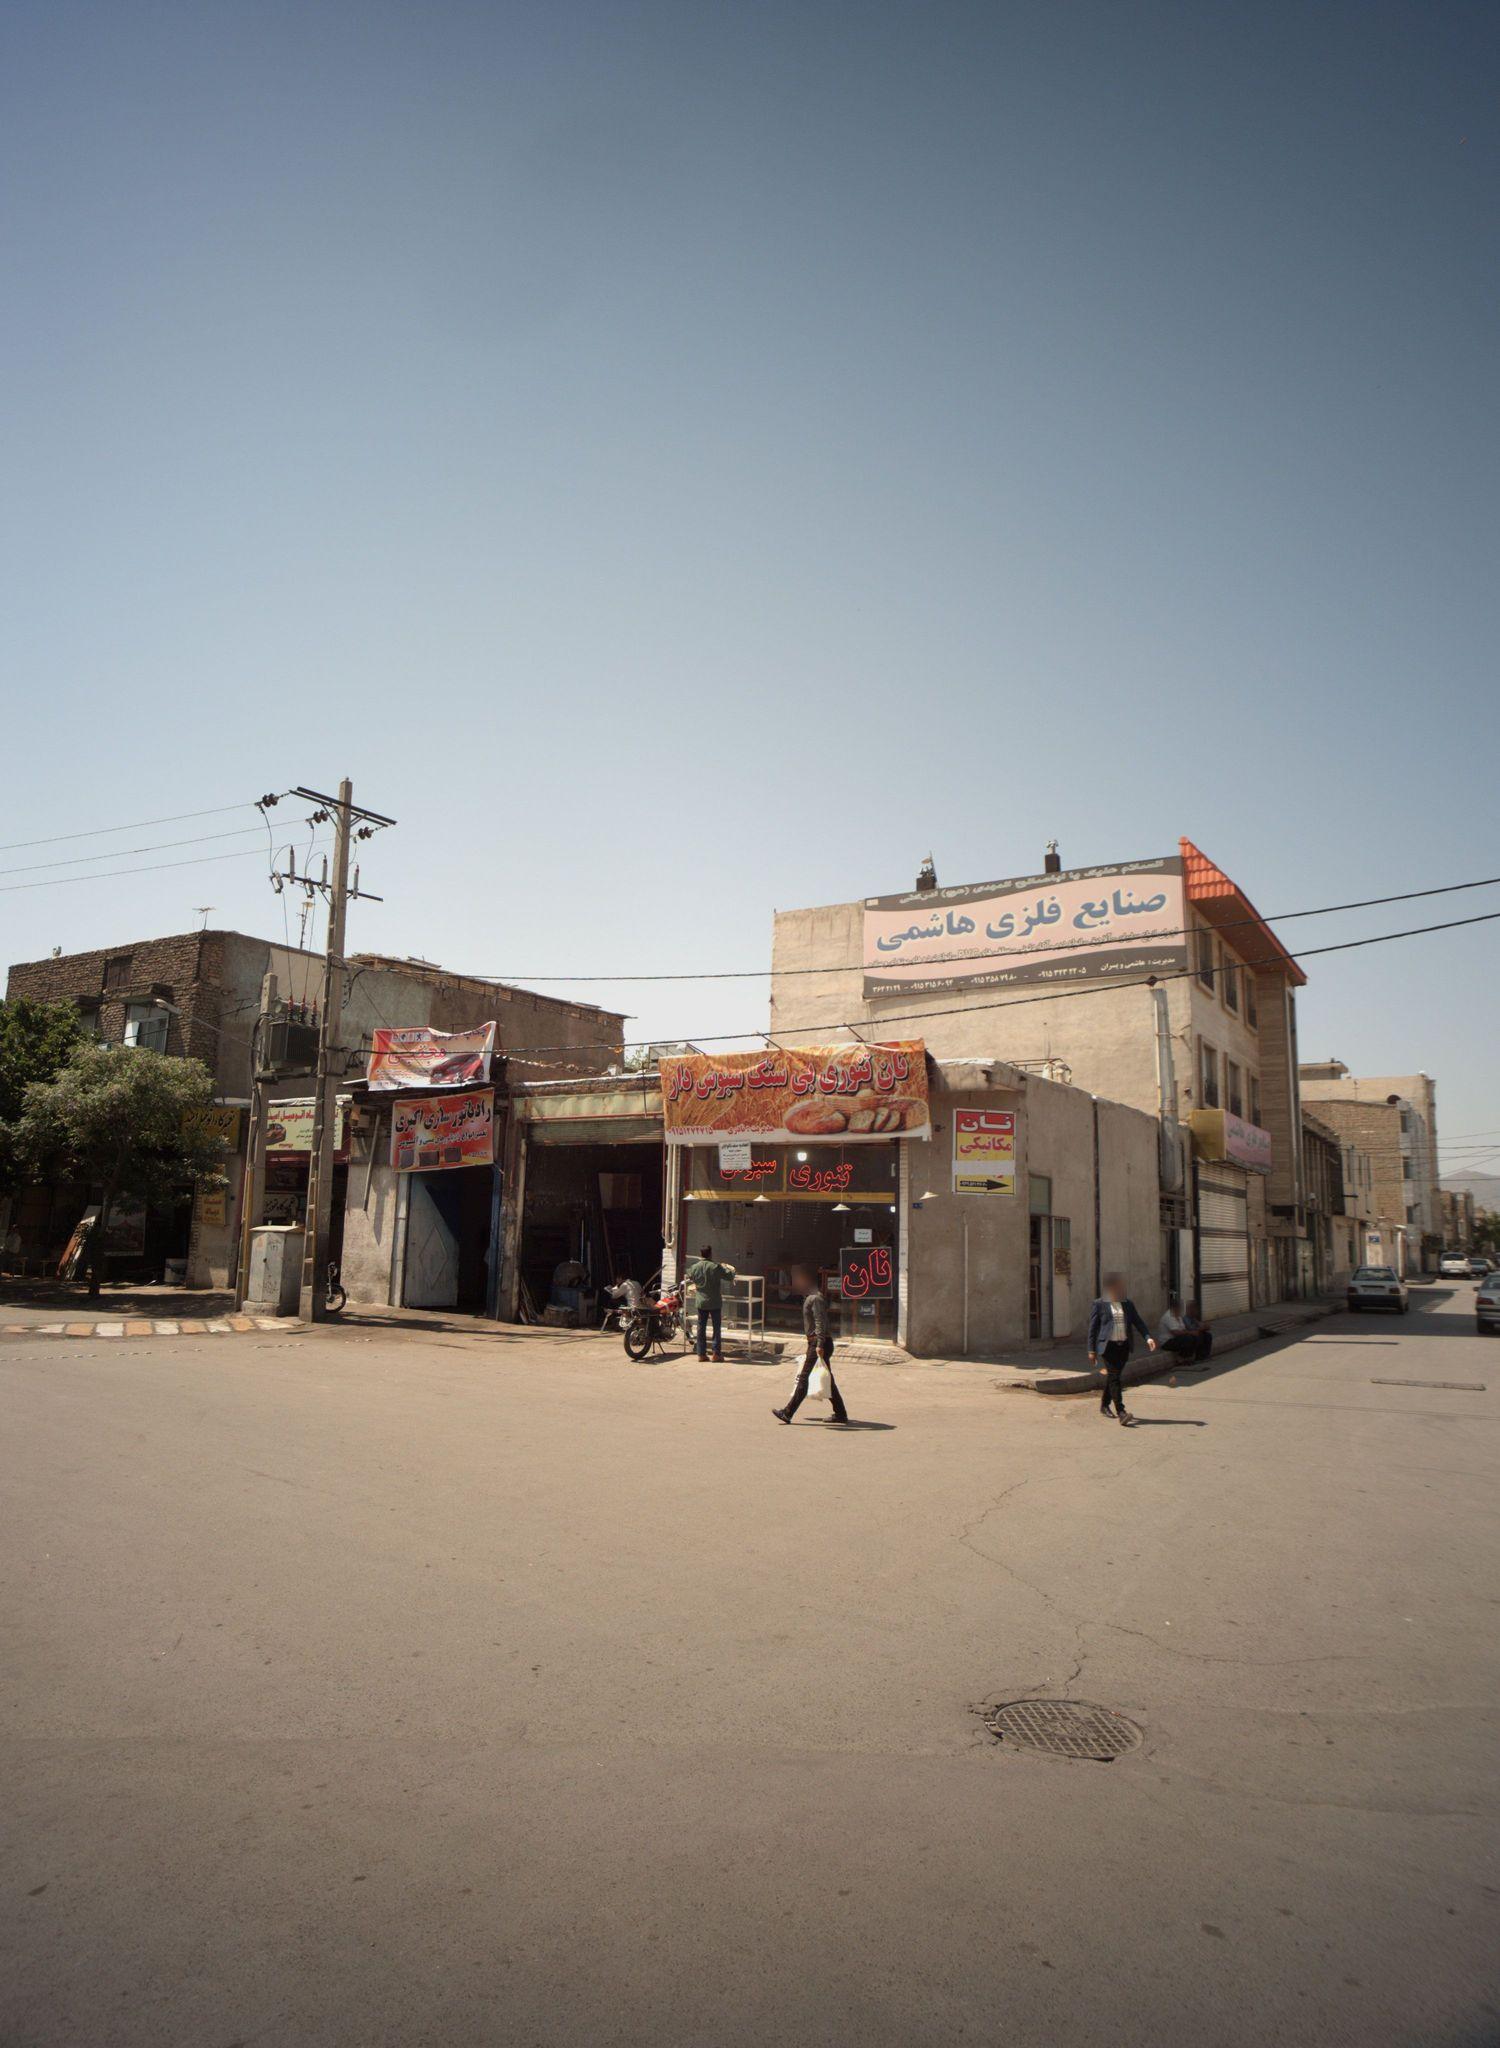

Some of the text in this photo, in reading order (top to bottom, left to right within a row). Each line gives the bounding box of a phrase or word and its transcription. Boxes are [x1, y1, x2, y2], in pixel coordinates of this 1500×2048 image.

[985, 895, 1063, 940] فلزی
[1073, 889, 1167, 930] صنایع
[875, 910, 976, 951] هاشمی
[669, 1053, 909, 1100] نان تنوری بی سنگ سبوس دار
[395, 1107, 424, 1132] اکبری
[423, 1106, 450, 1130] سازی
[960, 1115, 1012, 1131] نان
[960, 1136, 1013, 1154] مکانیکی
[790, 1163, 854, 1192] تنوری
[842, 1249, 892, 1298] نان
